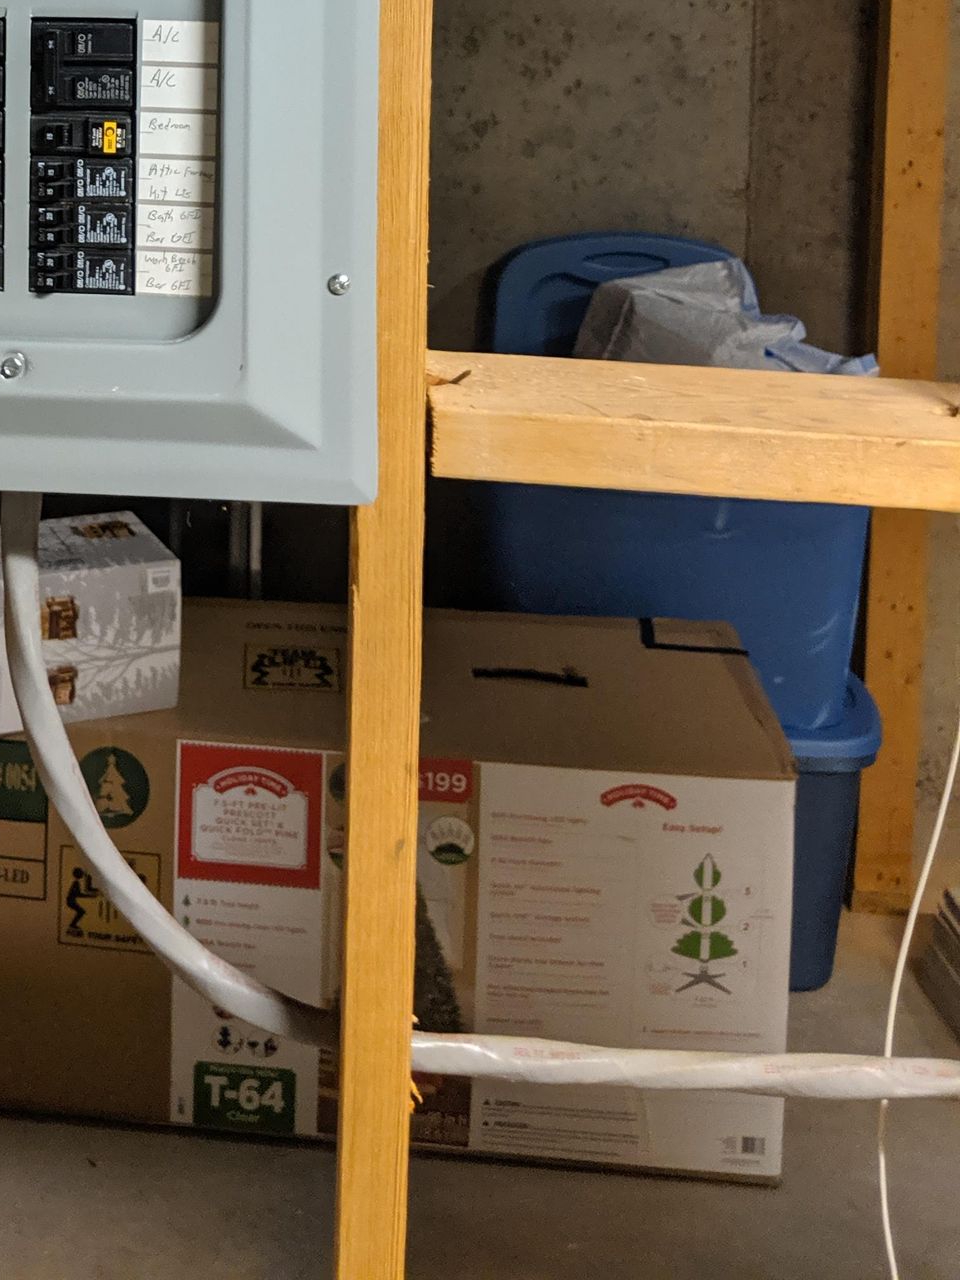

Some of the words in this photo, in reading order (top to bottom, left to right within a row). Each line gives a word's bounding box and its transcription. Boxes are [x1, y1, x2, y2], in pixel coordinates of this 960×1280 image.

[152, 24, 180, 45] A/C
[149, 68, 177, 89] A/C
[66, 928, 84, 938] FOR
[87, 931, 112, 940] YOUR
[203, 1074, 286, 1115] T-64
